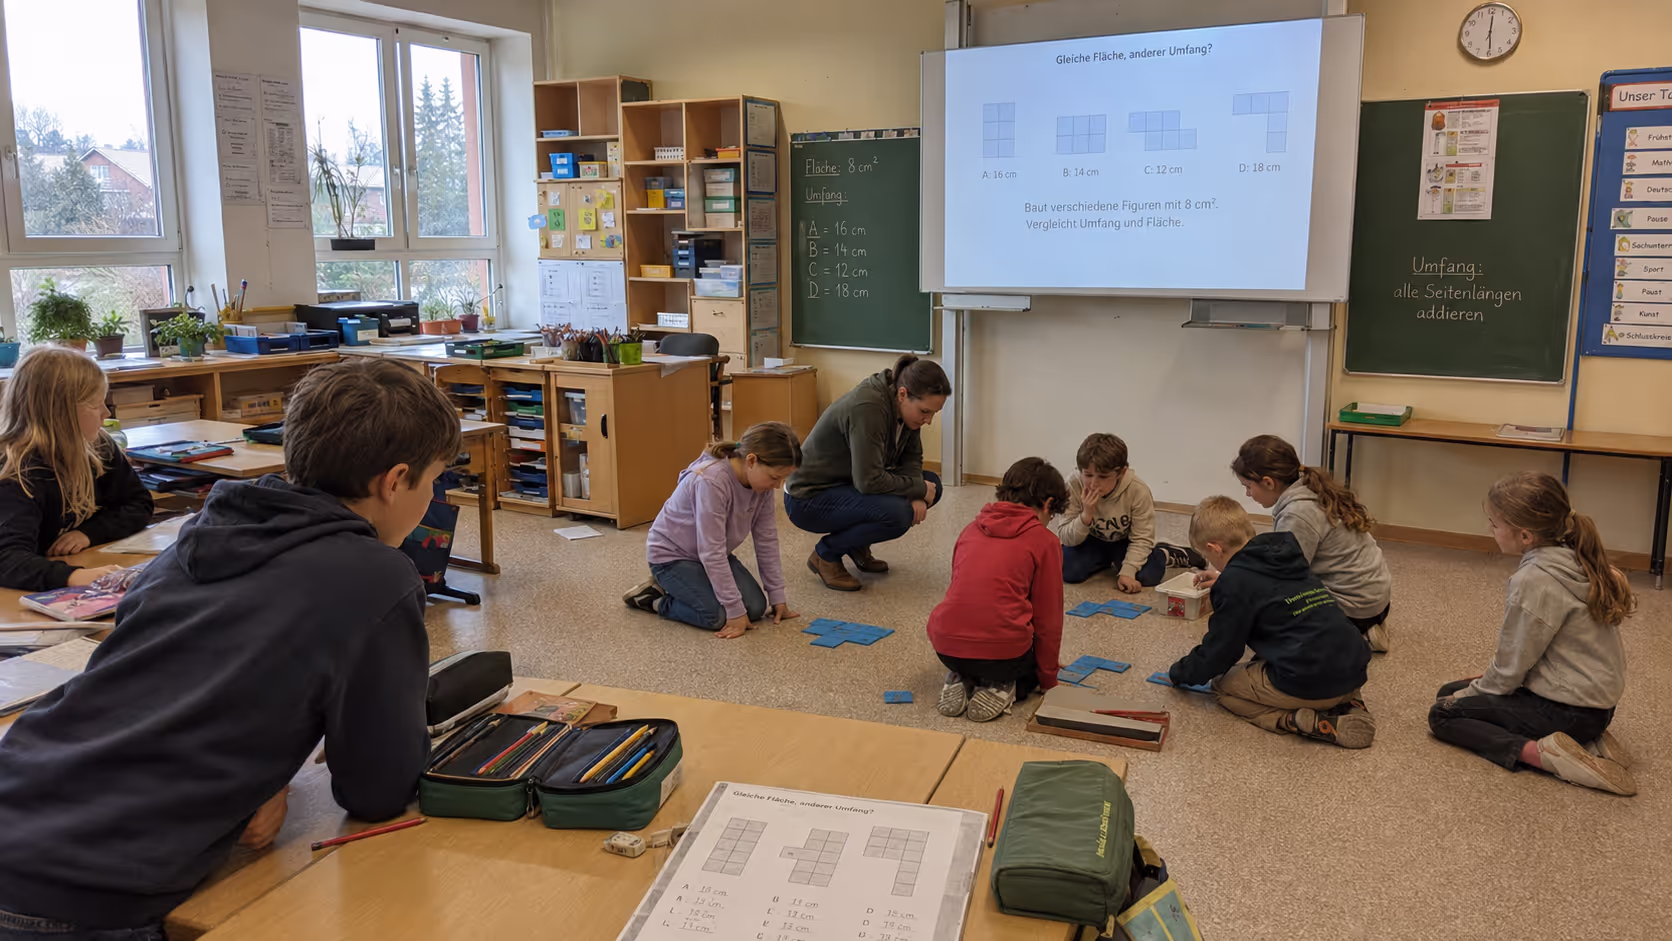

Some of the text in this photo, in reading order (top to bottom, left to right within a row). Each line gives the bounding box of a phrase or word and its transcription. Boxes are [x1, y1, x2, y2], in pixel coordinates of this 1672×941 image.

[1056, 44, 1213, 65] Gleiche Fläche, anderer Umfang?
[1619, 91, 1656, 102] Unser
[806, 158, 841, 175] Fläche:
[848, 158, 855, 173] 8
[982, 170, 1017, 179] A: 16 cm
[1063, 168, 1099, 177] B: 14 cm
[1144, 165, 1183, 174] C: 12 cm
[1239, 163, 1281, 172] D: 18 cm
[806, 187, 847, 206] Umfang:
[1025, 203, 1047, 213] Baut
[1051, 201, 1119, 212] verschiedene
[1122, 200, 1161, 213] Figuren
[1164, 200, 1182, 210] mit
[1185, 199, 1192, 210] 8
[809, 220, 818, 236] A
[835, 221, 847, 235] 16
[852, 226, 866, 235] cm
[1026, 217, 1184, 232] Vergleicht Umfang und Fläche.
[809, 241, 818, 258] B
[835, 242, 847, 257] 14
[852, 248, 867, 257] cm
[809, 262, 818, 277] C
[836, 263, 849, 278] 12
[852, 268, 868, 277] cm
[1412, 256, 1482, 281] Umfang:
[809, 281, 819, 298] D
[836, 283, 849, 298] 18
[853, 288, 869, 298] cm
[1394, 282, 1522, 308] alle Seitenlängen
[1416, 304, 1484, 322] addieren
[733, 791, 765, 800] Gleiche
[800, 801, 833, 810] anderer
[835, 805, 874, 815] Umfang?
